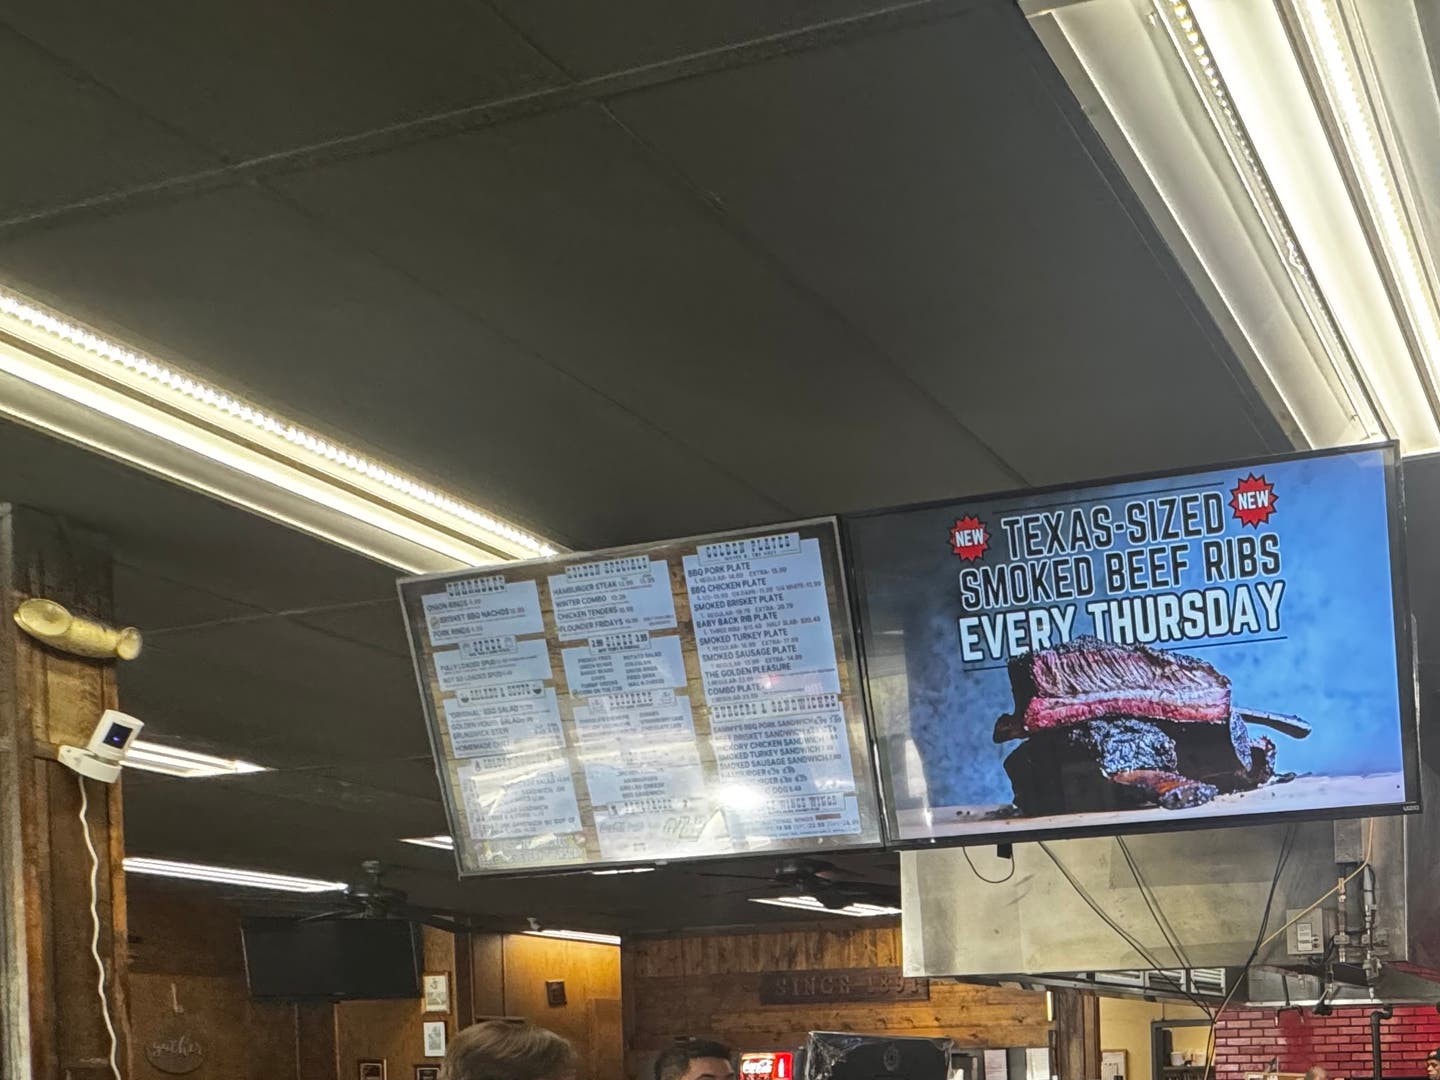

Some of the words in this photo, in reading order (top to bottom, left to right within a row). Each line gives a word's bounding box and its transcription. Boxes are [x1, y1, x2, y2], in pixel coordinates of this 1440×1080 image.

[1237, 489, 1269, 510] NEW
[1001, 492, 1225, 560] TEXAS-SIZED
[955, 527, 984, 548] NEW
[688, 568, 703, 577] BBQ
[705, 565, 725, 574] PORK
[727, 562, 750, 572] PLATE
[959, 555, 1096, 613] SMOKED
[1105, 544, 1192, 594] BEEF
[1203, 533, 1282, 584] RIBS
[554, 583, 594, 594] HAMBURGER
[596, 580, 617, 590] STEAK
[691, 585, 706, 594] BBQ
[708, 580, 741, 591] CHICKEN
[743, 578, 767, 587] PLATE
[556, 598, 581, 608] WINTER
[582, 595, 607, 604] COMBO
[694, 601, 725, 612] SMOKED
[727, 597, 757, 608] BRISKET
[760, 593, 784, 603] PLATE
[481, 608, 509, 617] NACHOS
[557, 611, 587, 620] CHICKEN
[588, 607, 618, 616] TENDERS
[559, 622, 594, 632] FLOUNDER
[595, 618, 623, 628] FRIDAYS
[697, 619, 719, 628] BABY
[720, 616, 740, 626] BACK
[741, 614, 752, 623] RIB
[754, 612, 778, 620] PLATE
[958, 602, 1077, 663] EVERY
[1088, 580, 1285, 644] THURSDAY
[700, 636, 731, 646] SMOKED
[732, 631, 762, 641] TURKEY
[764, 628, 788, 638] PLATE
[703, 652, 733, 662] SMOKED
[735, 647, 771, 658] SAUSAGE
[773, 644, 796, 654] PLATE
[721, 667, 752, 677] GOLDEN
[752, 663, 791, 673] PLEASURE
[708, 685, 735, 696] COMBO
[737, 682, 760, 692] PLATE
[777, 719, 813, 727] SANDWICH
[750, 740, 783, 749] CHICKEN
[719, 752, 748, 760] SMOKED
[780, 746, 820, 755] SANDWICH
[752, 759, 785, 767] SAUSAGE
[788, 754, 828, 763] SANDWICH
